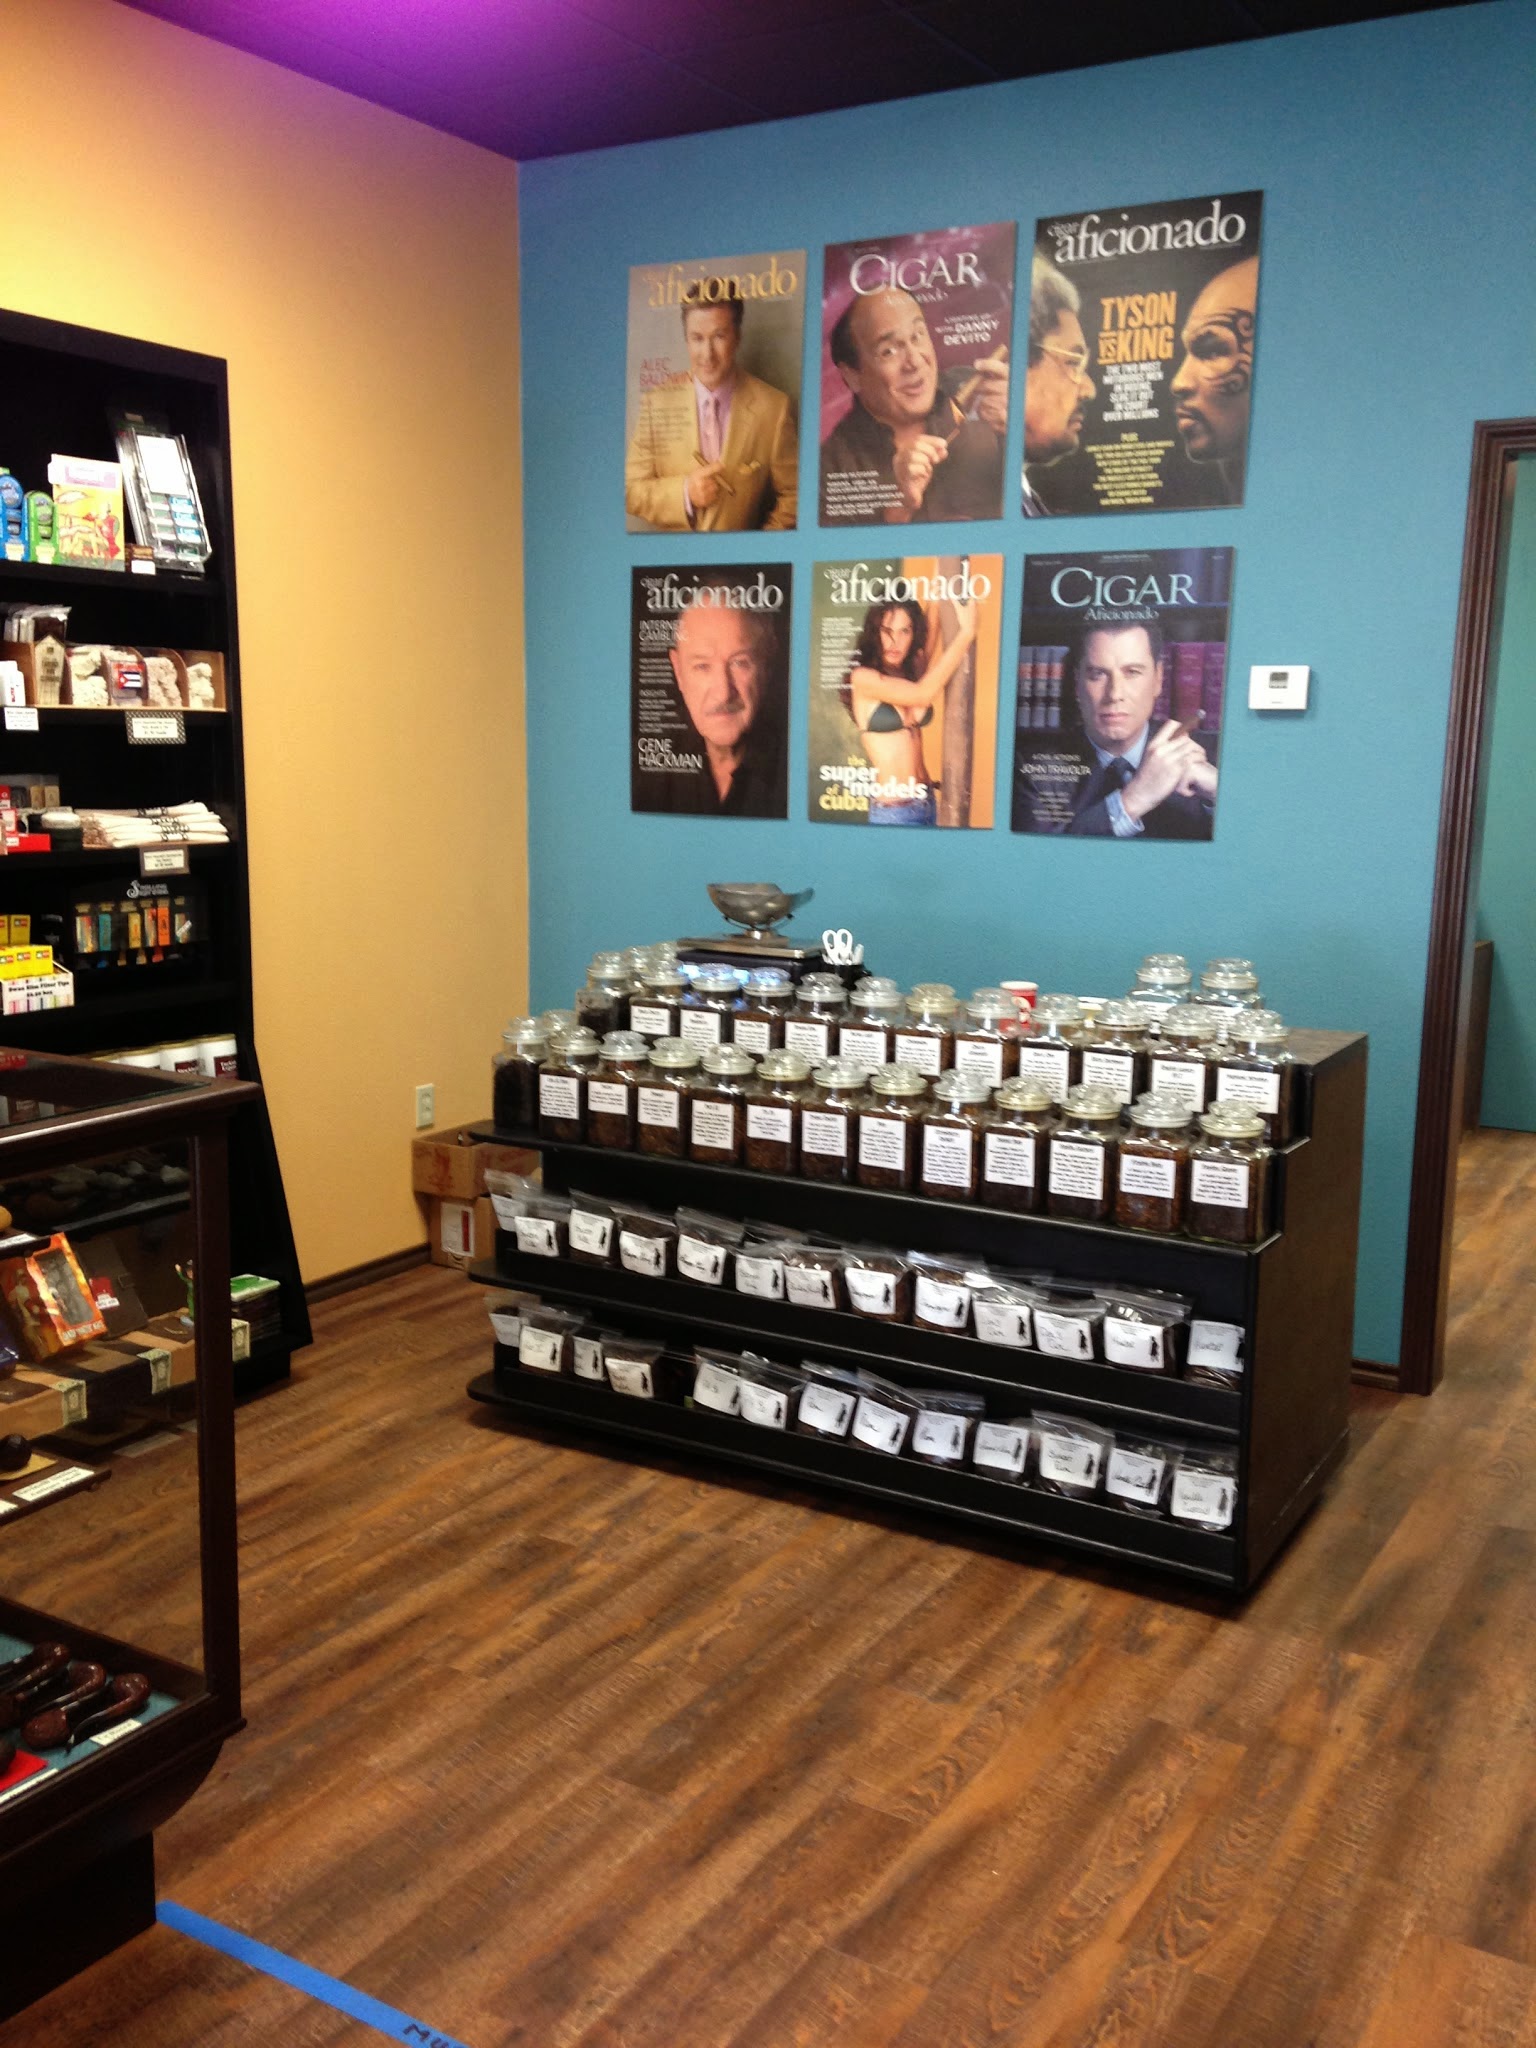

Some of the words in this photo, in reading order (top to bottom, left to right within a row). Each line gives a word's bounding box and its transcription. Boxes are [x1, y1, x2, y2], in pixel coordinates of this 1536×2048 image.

[1055, 199, 1247, 264] aficionado
[648, 256, 797, 306] aficionado
[849, 252, 982, 296] CIGAR
[1100, 290, 1177, 330] TYSON
[943, 331, 991, 346] DEVITO
[955, 319, 1000, 334] DANNY
[1098, 338, 1117, 360] VS
[1116, 325, 1175, 362] KING
[646, 571, 784, 609] aficionado
[830, 560, 991, 603] aficionado
[1050, 566, 1198, 607] CIGAR
[1084, 605, 1159, 621] Aficionado
[639, 630, 689, 641] GAMBLING
[638, 738, 673, 752] GENE
[638, 752, 703, 769] HACKMAN
[847, 754, 867, 766] the
[1019, 763, 1048, 774] JOHN
[1047, 764, 1092, 775] TRAVOLTA
[819, 765, 879, 788] super
[849, 774, 928, 800] models
[819, 787, 869, 812] cuba
[826, 783, 840, 795] of
